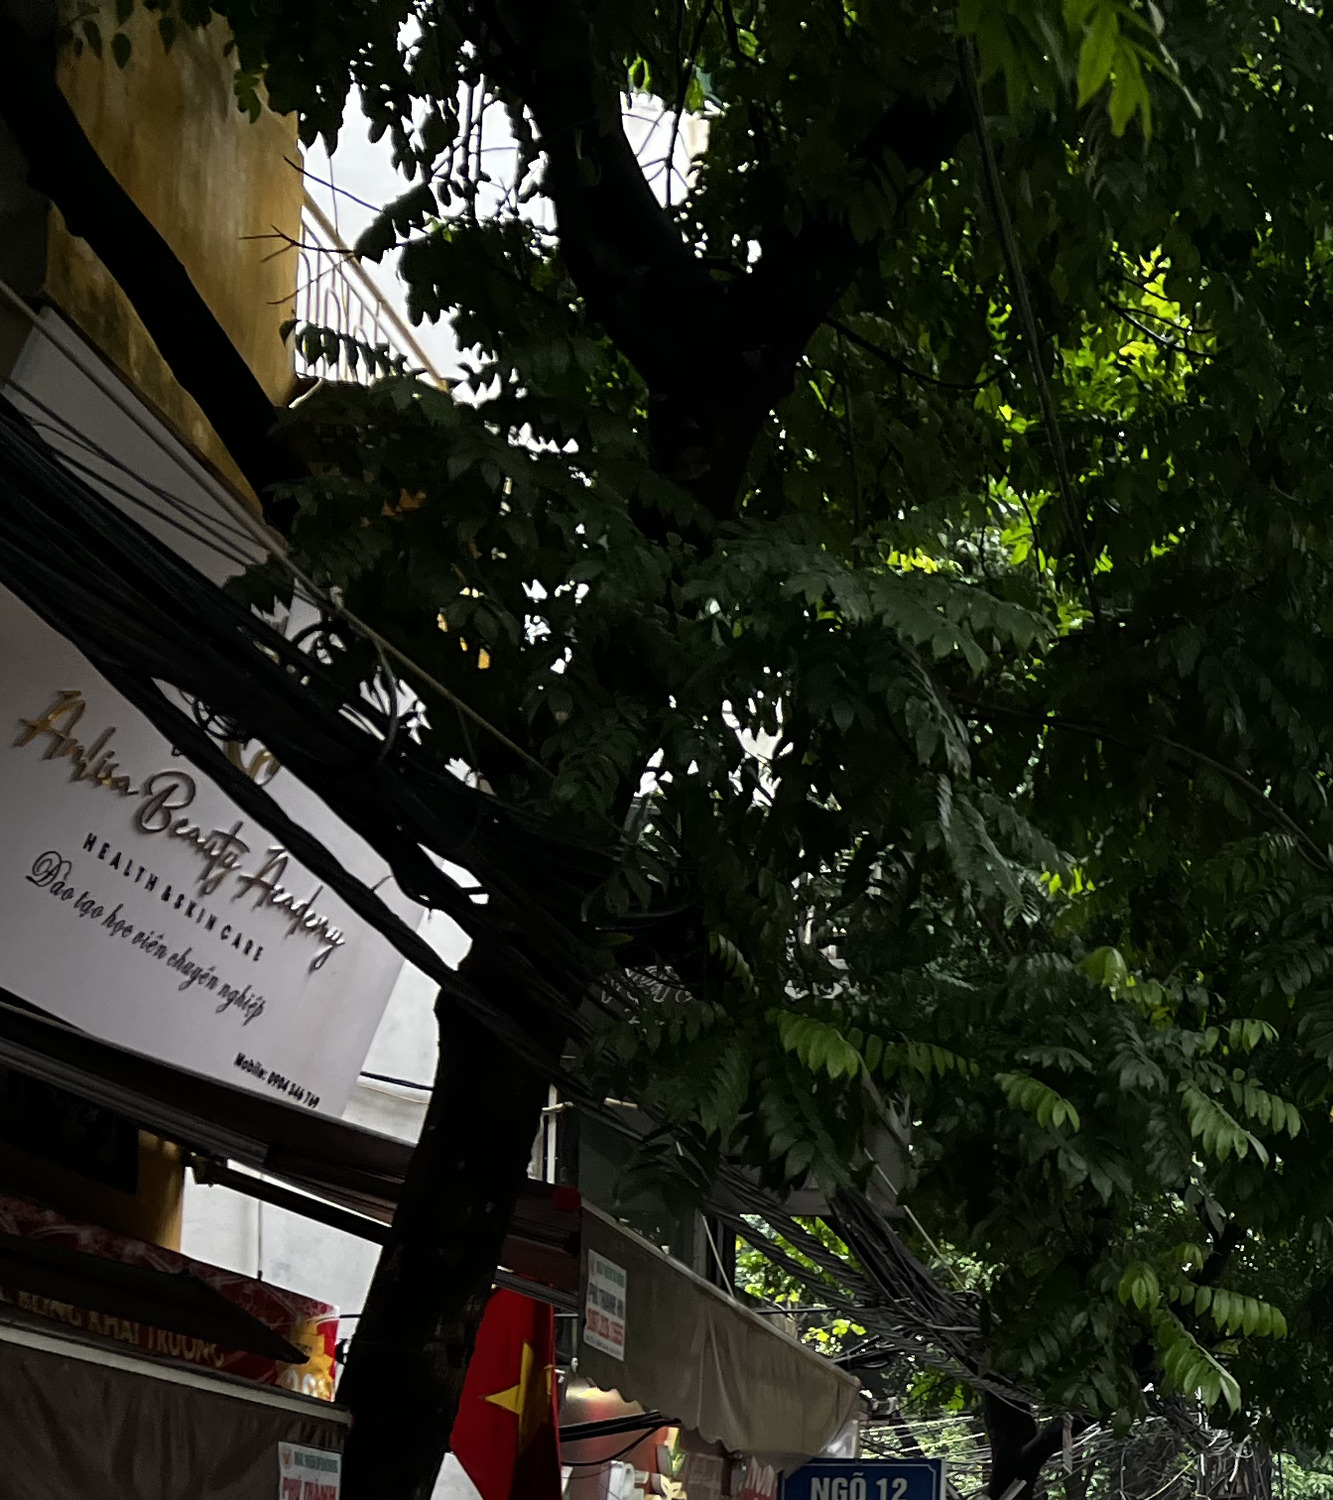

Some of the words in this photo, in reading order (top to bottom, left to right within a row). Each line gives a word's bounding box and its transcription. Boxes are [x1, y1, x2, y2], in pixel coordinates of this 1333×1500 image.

[83, 833, 157, 892] HEALTH
[172, 895, 216, 931] SKIN
[220, 926, 264, 962] CARE
[138, 771, 250, 897] Beauty
[236, 847, 345, 970] Academy
